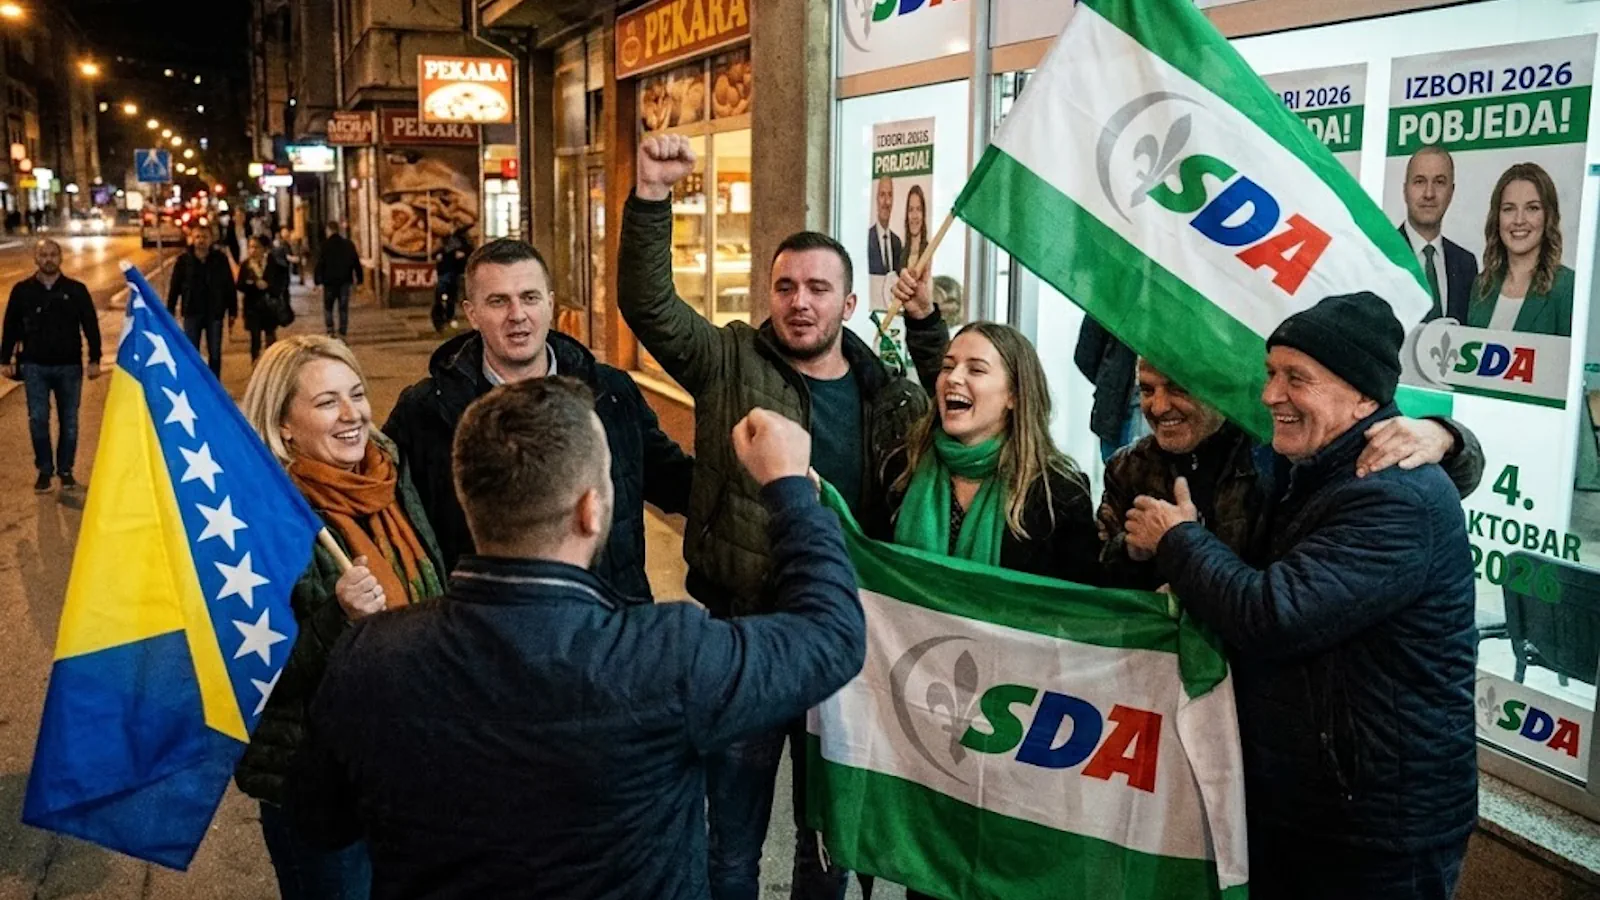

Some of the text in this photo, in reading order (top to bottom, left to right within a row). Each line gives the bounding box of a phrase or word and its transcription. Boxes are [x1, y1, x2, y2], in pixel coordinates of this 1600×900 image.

[645, 0, 748, 59] PEKARA
[424, 60, 509, 82] PEKARA
[1406, 61, 1573, 99] IZBORI 2026
[1276, 85, 1350, 109] RI 2026
[392, 117, 473, 138] PEKARA
[1302, 113, 1351, 144] DA!
[1398, 97, 1572, 146] POBJEDA!
[1146, 154, 1333, 296] SDA
[1453, 341, 1535, 383] SDA
[1492, 464, 1535, 511] 4.
[1468, 509, 1582, 562] KTOBAR
[959, 683, 1163, 793] SDA
[1497, 699, 1581, 757] SDA
